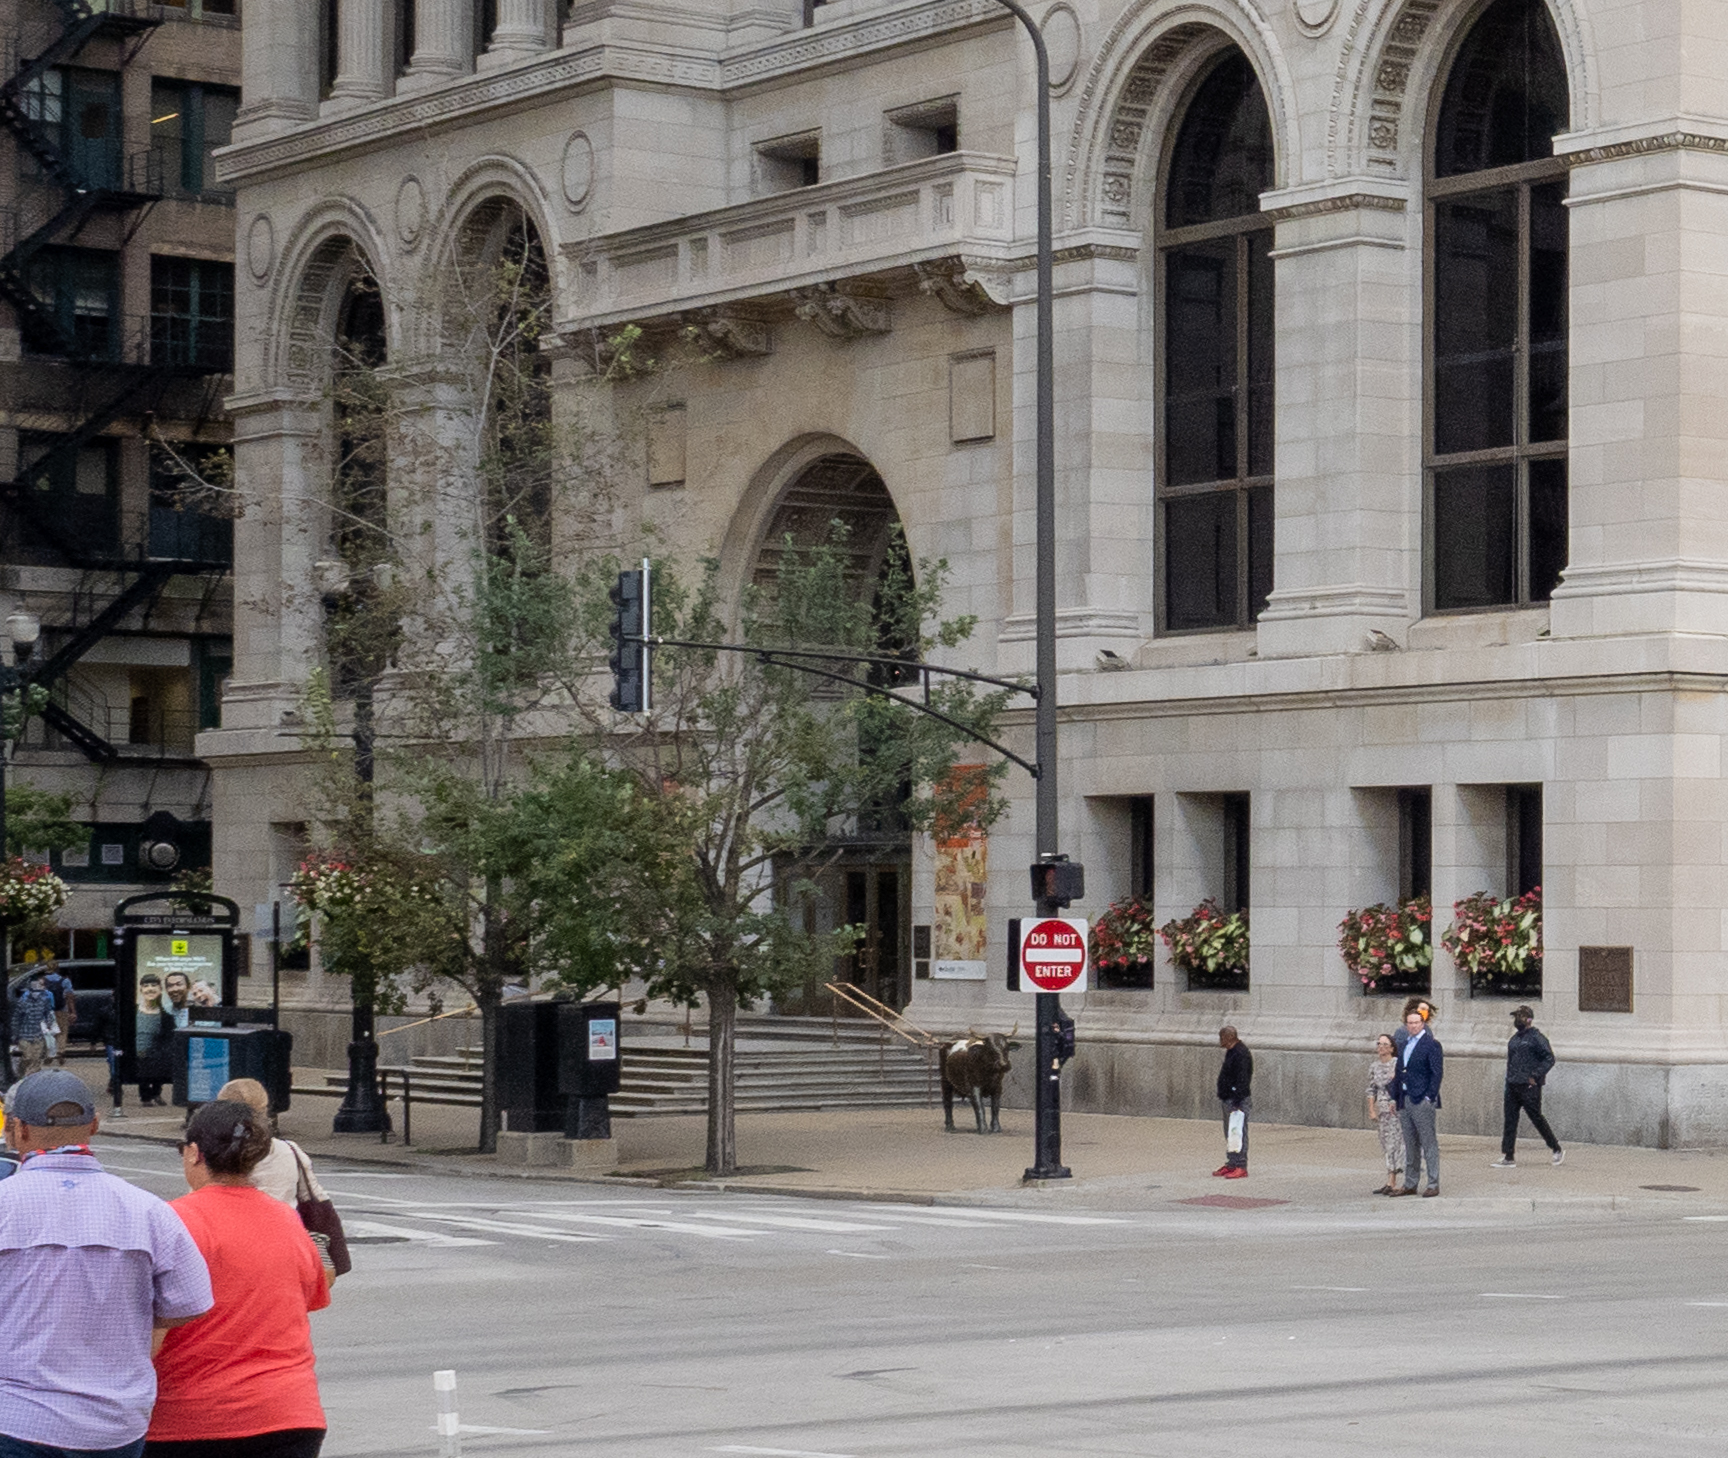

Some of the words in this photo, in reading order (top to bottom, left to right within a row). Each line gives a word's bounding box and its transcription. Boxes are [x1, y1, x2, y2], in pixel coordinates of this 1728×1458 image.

[1031, 933, 1047, 946] DO
[1053, 933, 1077, 946] NOT
[1035, 965, 1073, 978] ENTER
